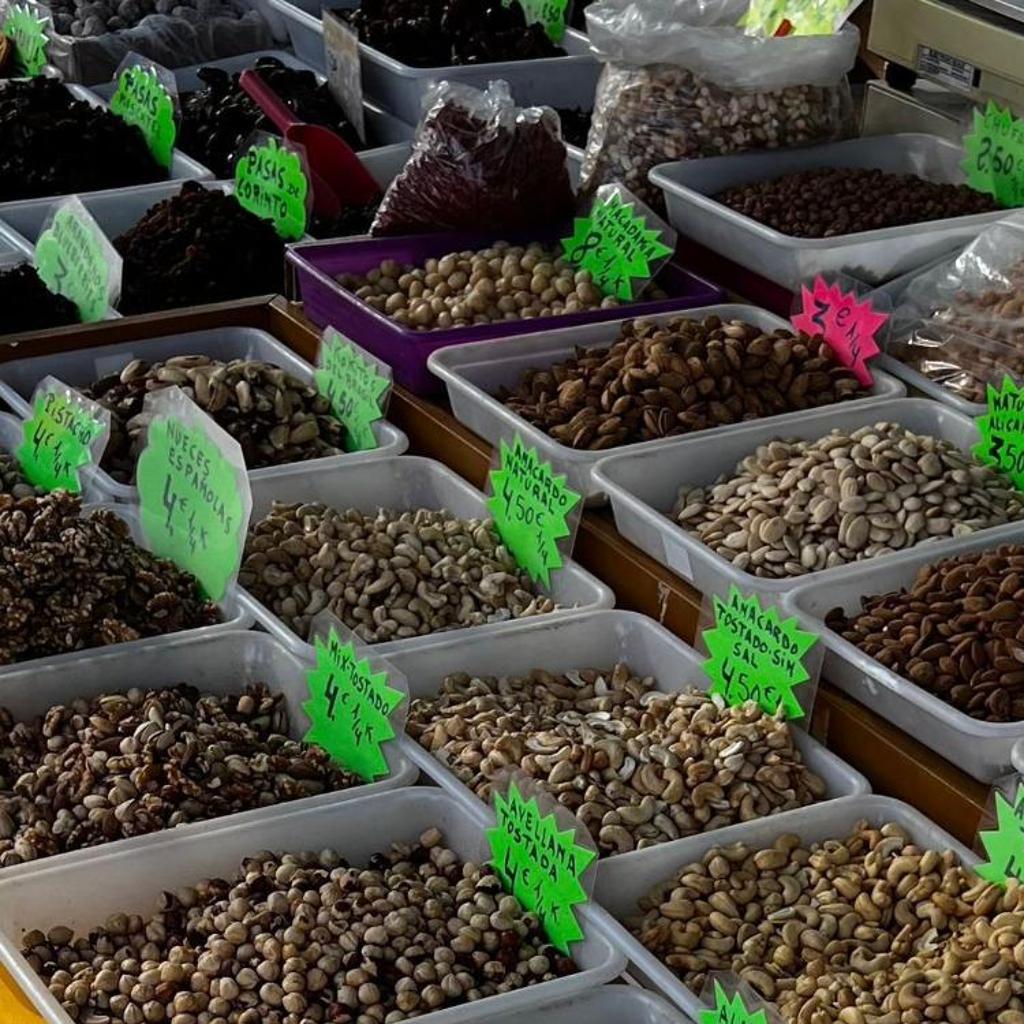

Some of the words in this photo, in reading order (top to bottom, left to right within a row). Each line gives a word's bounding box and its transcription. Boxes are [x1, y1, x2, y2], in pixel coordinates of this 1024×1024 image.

[247, 151, 287, 190] PASAS
[166, 420, 212, 477] NUECES
[515, 443, 568, 507] ANACARDO
[505, 454, 555, 515] NATURAL
[716, 602, 769, 654] TOSTADO
[731, 594, 799, 655] ANACARDO
[732, 642, 758, 669] SAL
[500, 807, 558, 883] TOSTADA
[510, 799, 576, 878] AVELLANA
